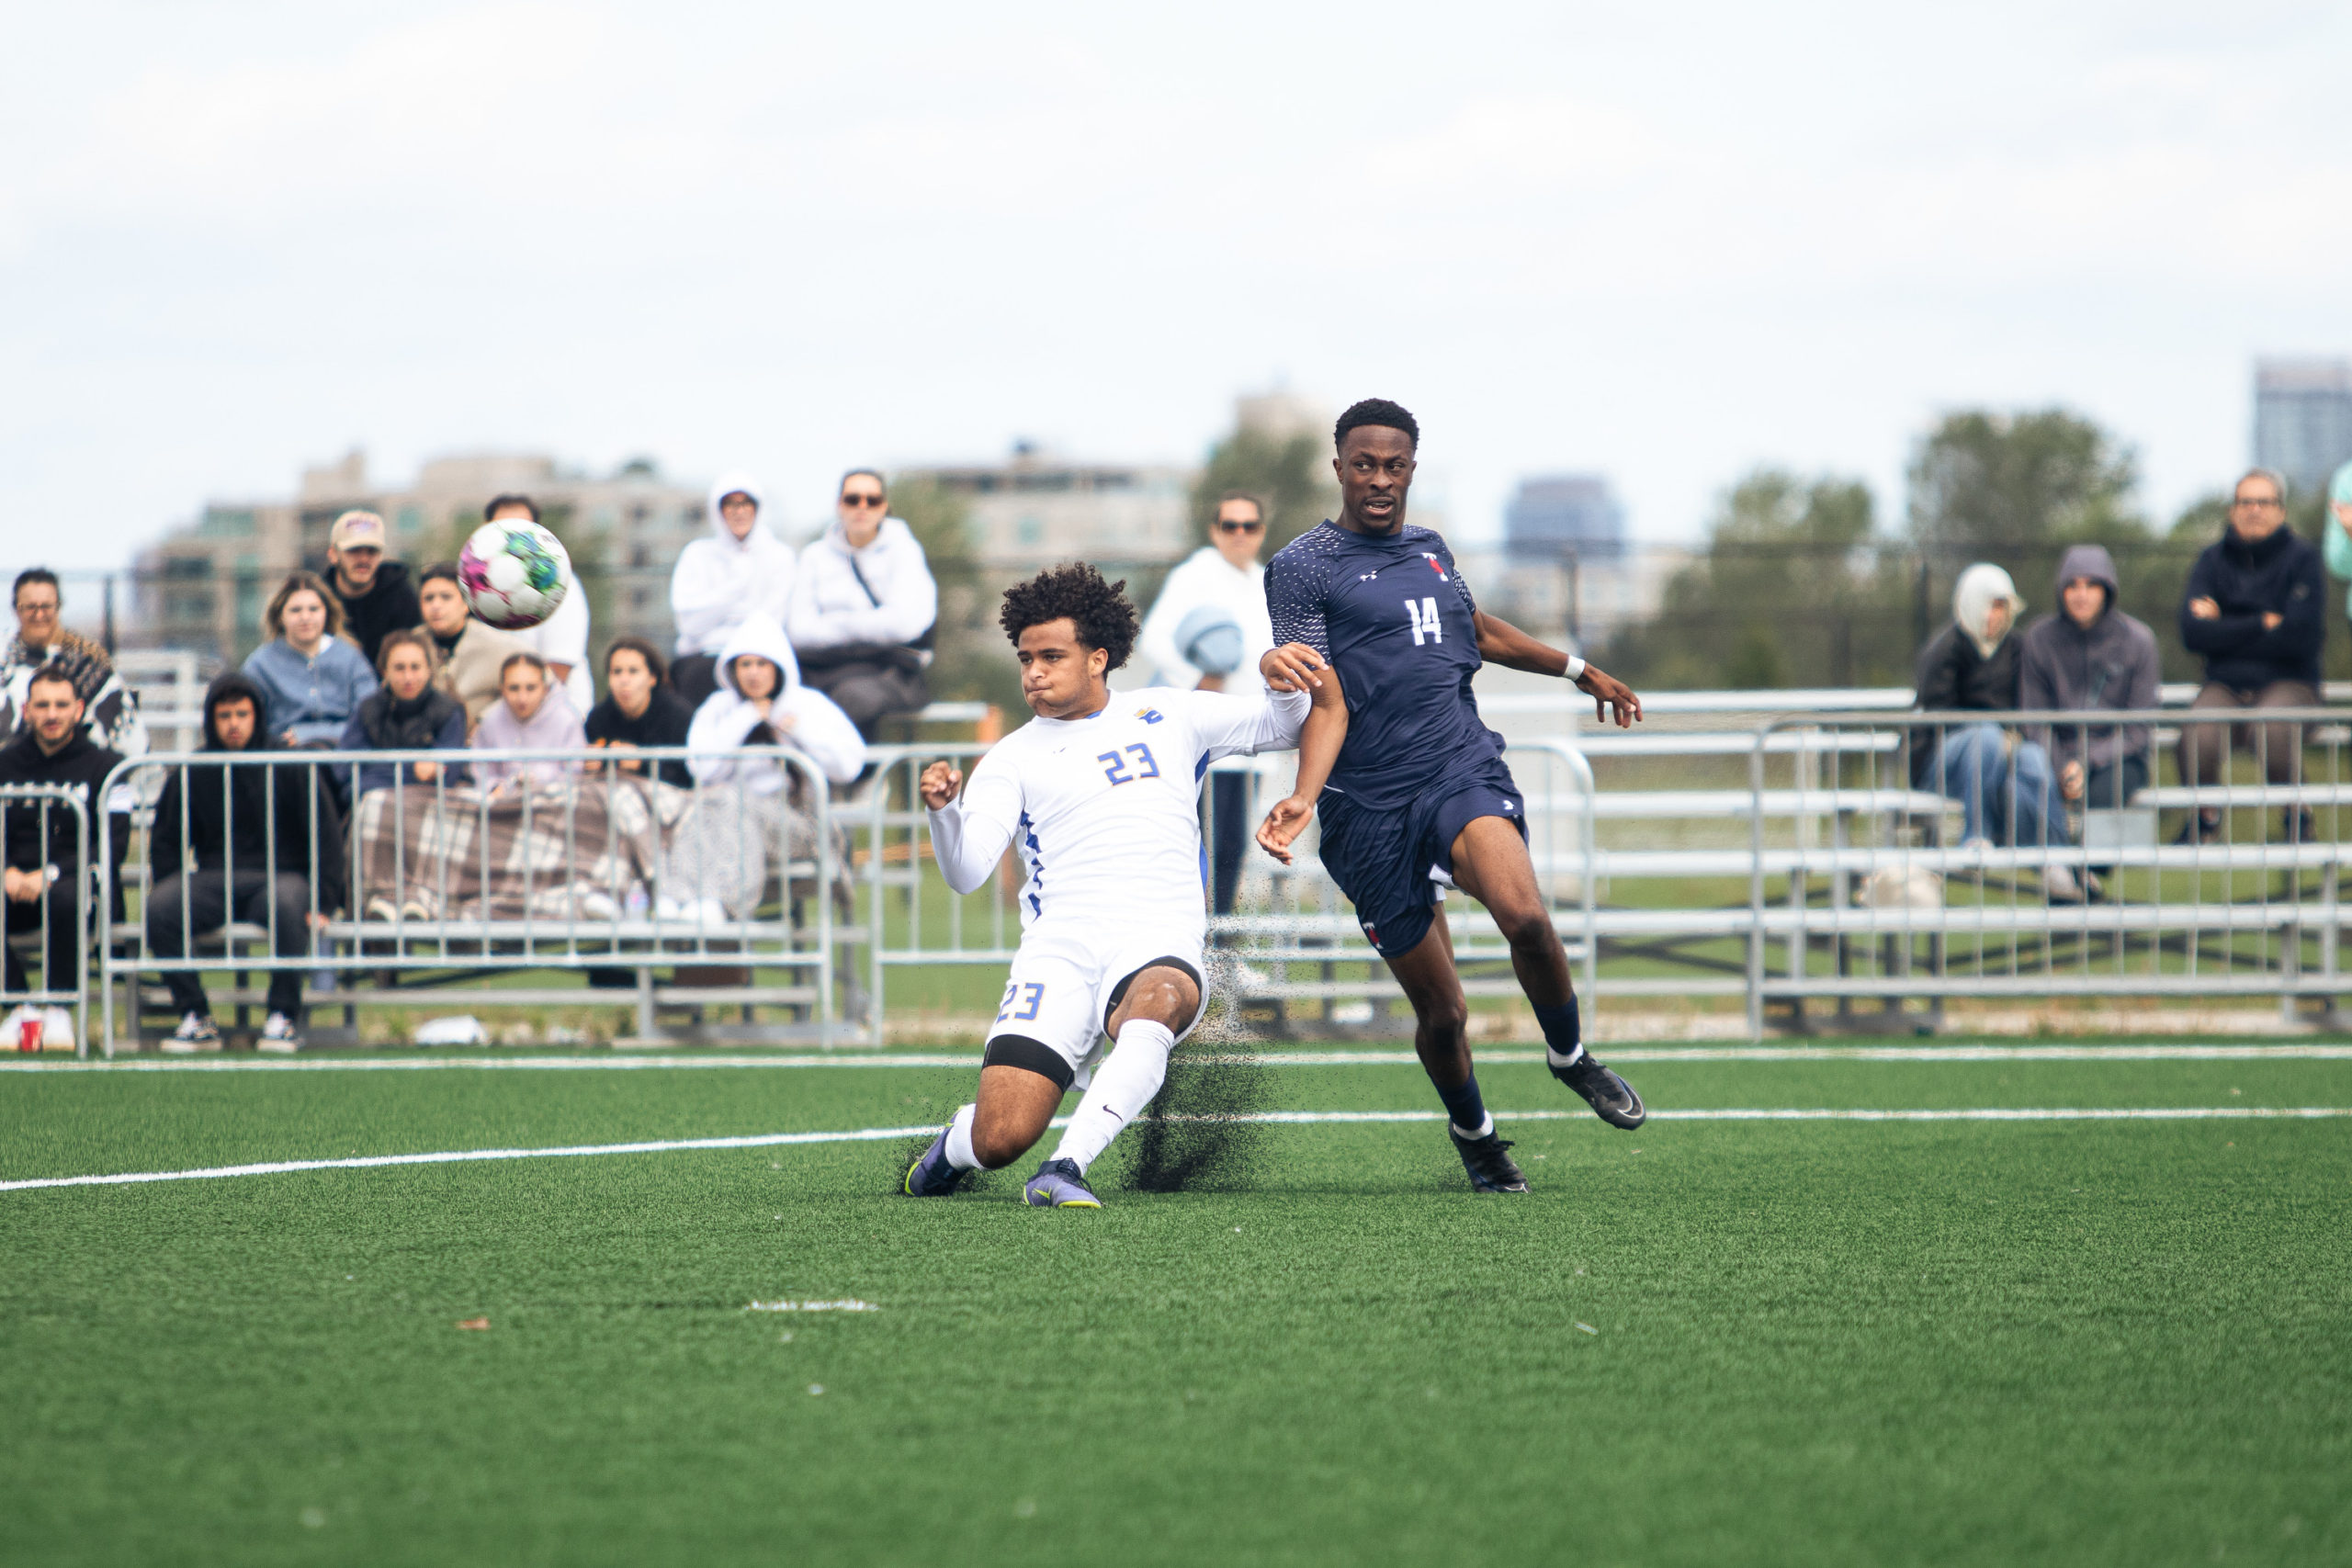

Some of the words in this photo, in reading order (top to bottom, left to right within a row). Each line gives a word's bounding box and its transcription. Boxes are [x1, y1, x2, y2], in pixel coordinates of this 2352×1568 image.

[1404, 596, 1442, 647] 14
[1097, 742, 1160, 787] 23
[995, 982, 1046, 1025] 23
